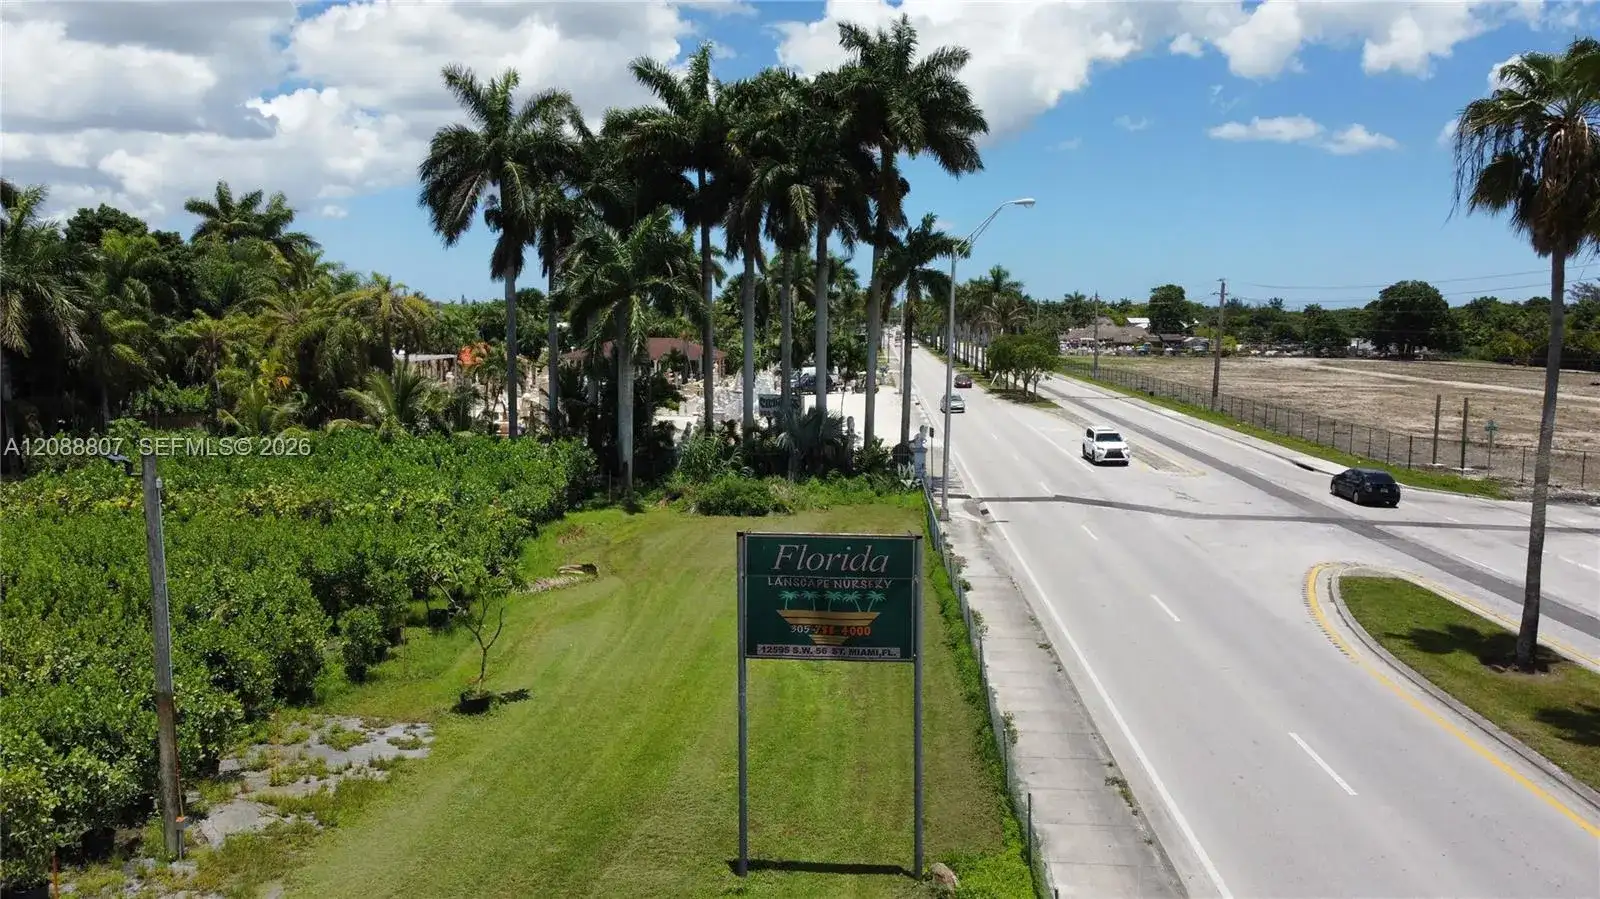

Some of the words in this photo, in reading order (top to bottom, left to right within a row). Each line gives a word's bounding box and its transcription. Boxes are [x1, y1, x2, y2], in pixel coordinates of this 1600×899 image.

[772, 544, 889, 573] Florida
[768, 577, 829, 588] LANSCAPE
[833, 580, 892, 589] NURSERY
[841, 627, 872, 636] 4000
[792, 647, 813, 655] S.W.
[816, 647, 827, 655] 56
